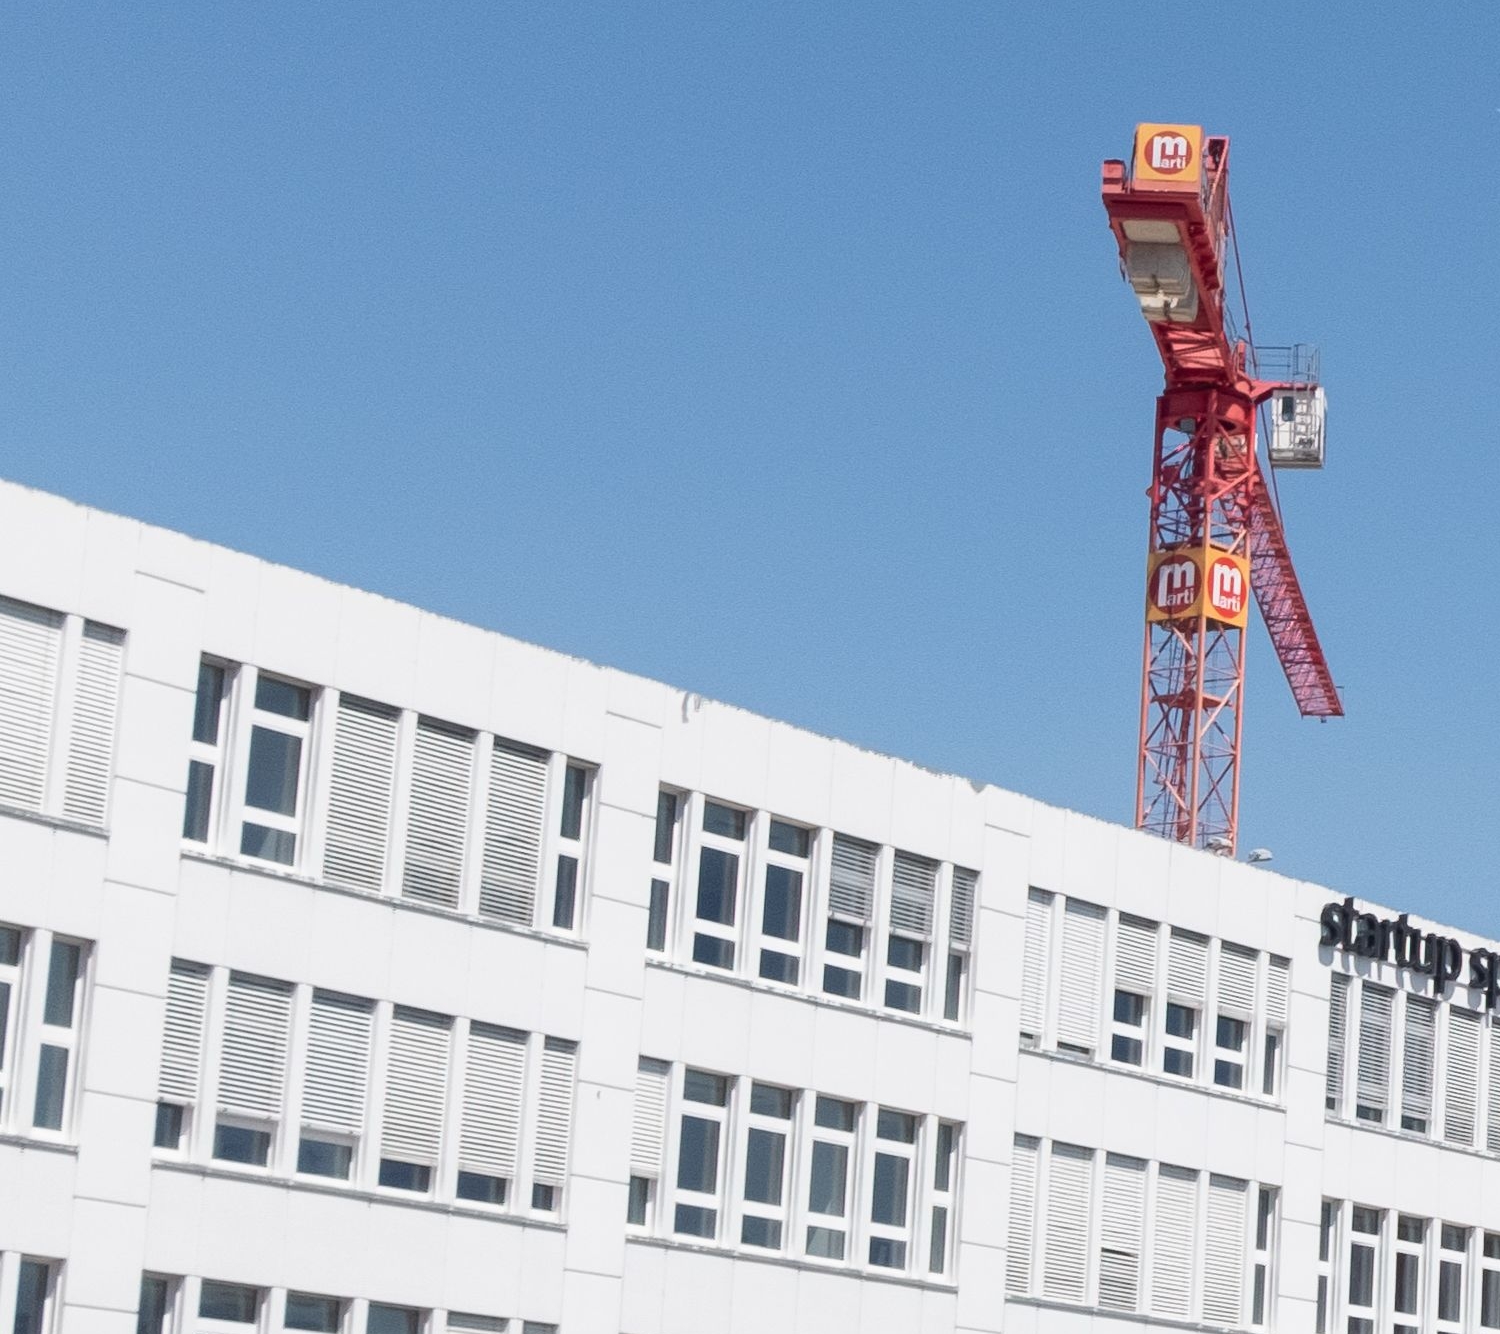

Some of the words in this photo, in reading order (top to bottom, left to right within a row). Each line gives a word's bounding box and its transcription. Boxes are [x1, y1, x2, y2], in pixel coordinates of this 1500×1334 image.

[1151, 135, 1188, 169] marti
[1157, 560, 1196, 608] marti
[1212, 562, 1242, 614] marti
[1319, 896, 1463, 995] startup
